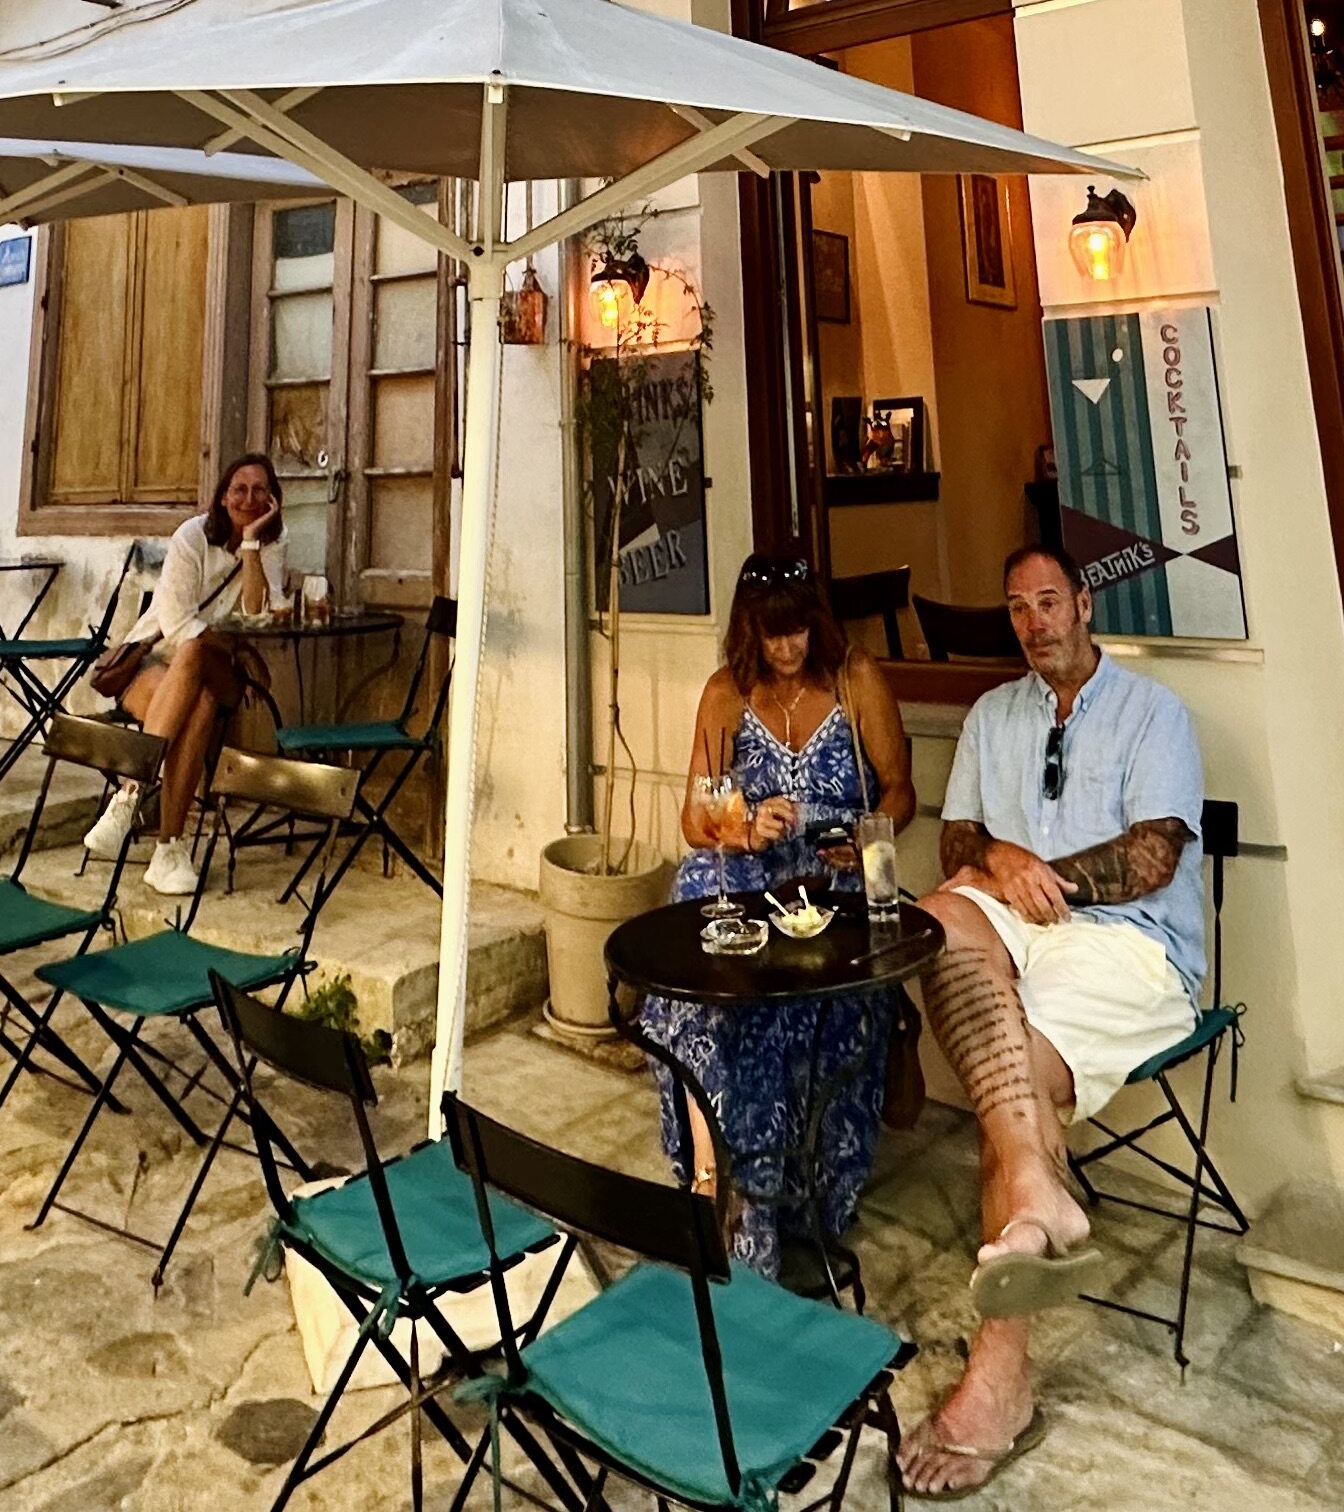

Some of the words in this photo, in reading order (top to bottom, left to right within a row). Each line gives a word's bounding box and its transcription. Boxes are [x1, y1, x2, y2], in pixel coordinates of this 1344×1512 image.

[1160, 323, 1201, 536] COCKTAILS
[608, 457, 689, 505] WINE
[617, 529, 688, 585] BEER
